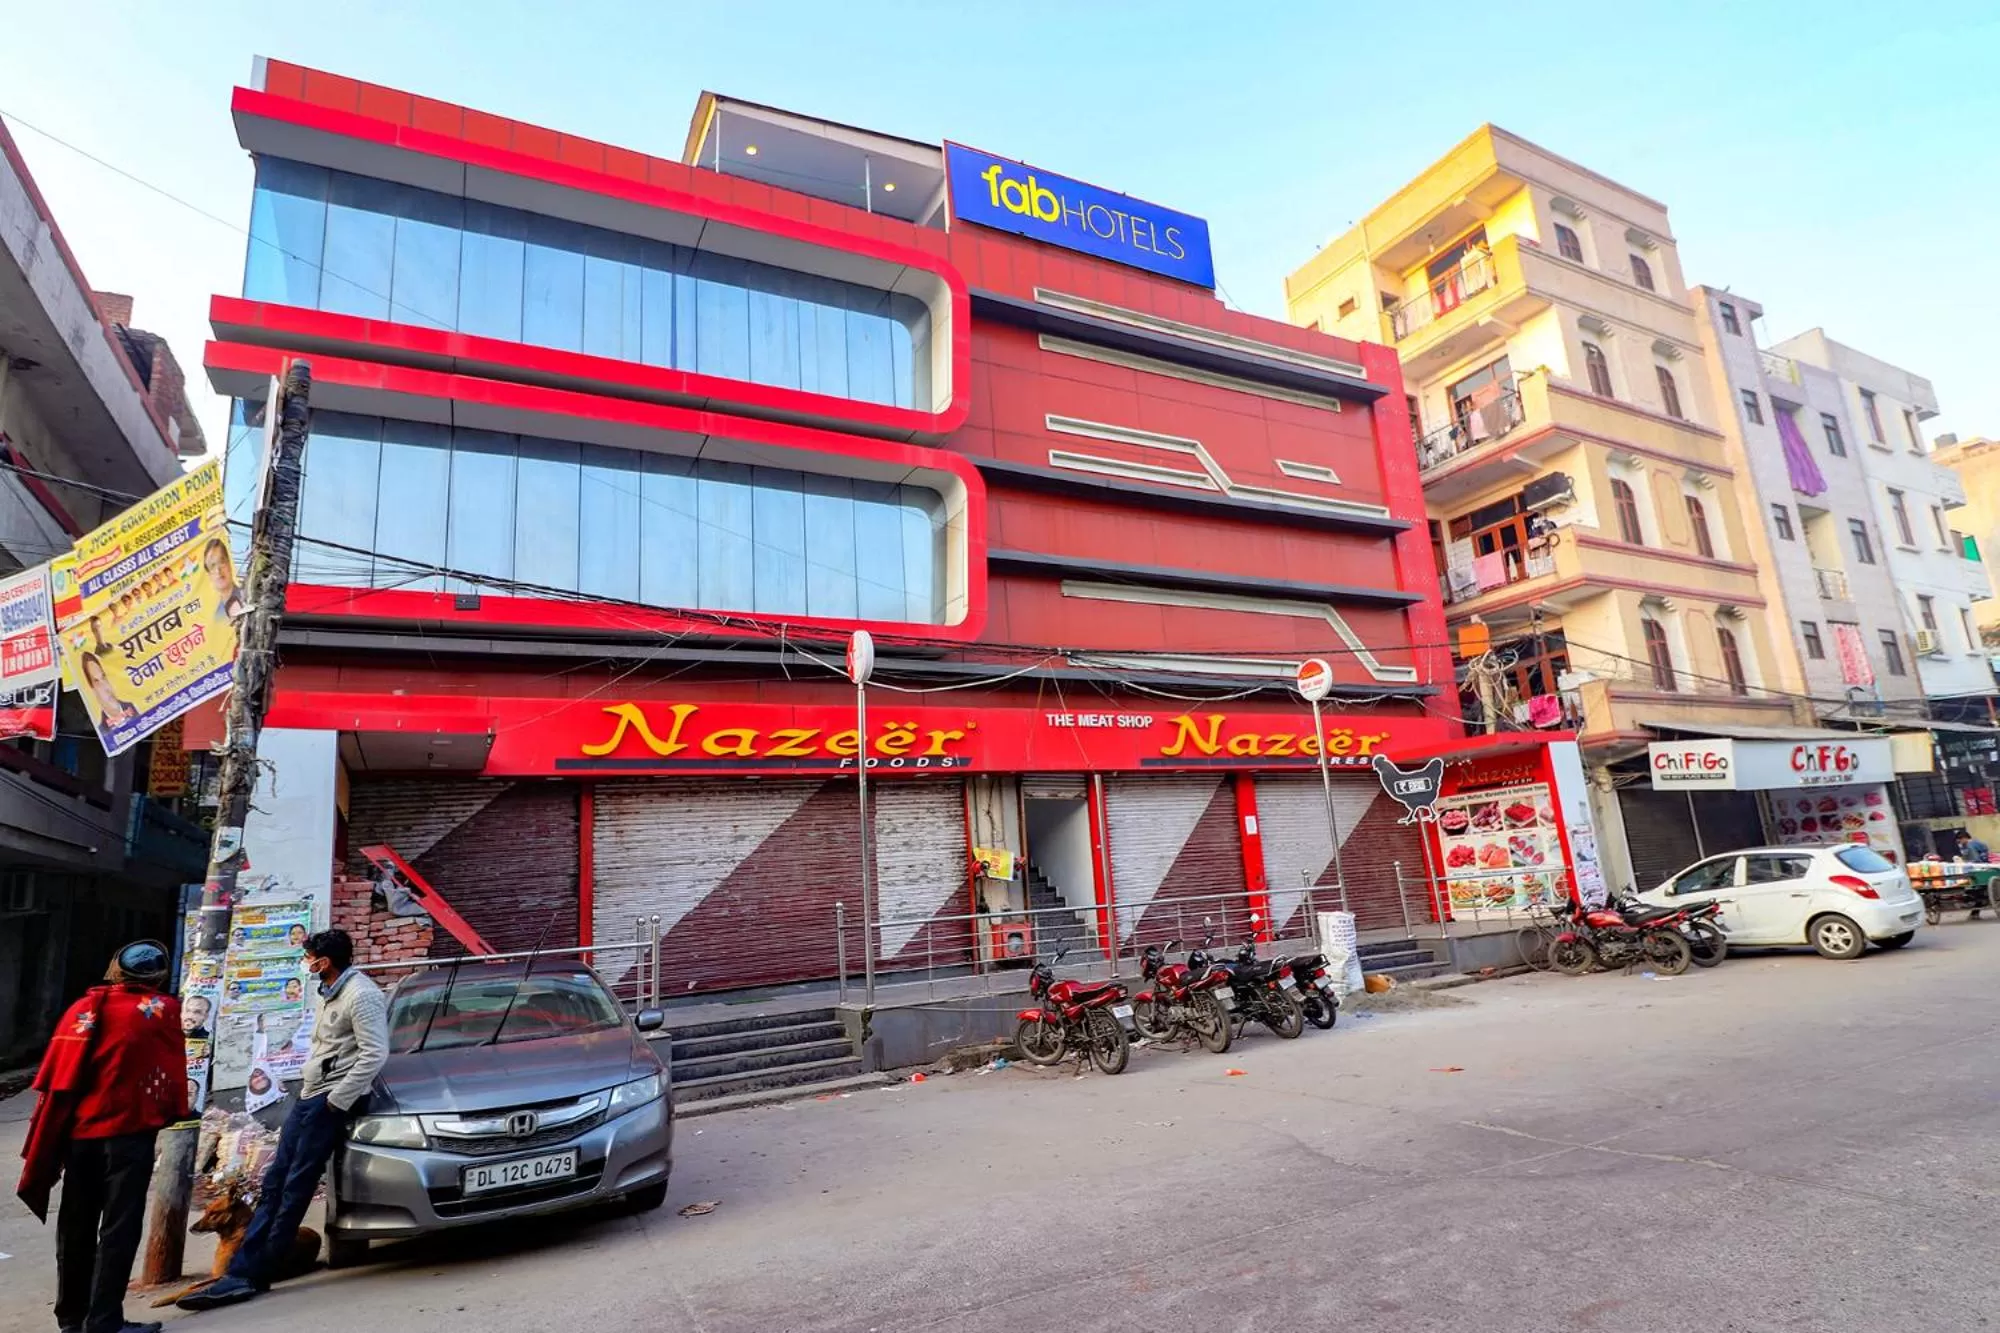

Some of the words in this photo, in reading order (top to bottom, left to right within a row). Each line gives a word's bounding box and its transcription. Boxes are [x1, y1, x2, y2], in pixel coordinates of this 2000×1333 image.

[185, 465, 219, 495] POINT
[88, 578, 101, 593] ALL
[103, 556, 137, 580] CLASSES
[138, 547, 151, 565] ALL
[153, 526, 192, 555] SUBJECT
[118, 606, 182, 659] शराब
[183, 599, 201, 614] का
[124, 652, 164, 686] ठेका
[164, 623, 205, 665] खुलने
[581, 702, 965, 757] Nazeër
[1046, 714, 1075, 727] THE
[1078, 714, 1114, 728] MEAT
[1118, 715, 1153, 729] SHOP
[839, 757, 954, 769] FOODS
[1654, 752, 1728, 771] ChiFiGo
[477, 1171, 496, 1187] DL
[502, 1163, 529, 1182] 12C
[535, 1156, 572, 1178] 0479
